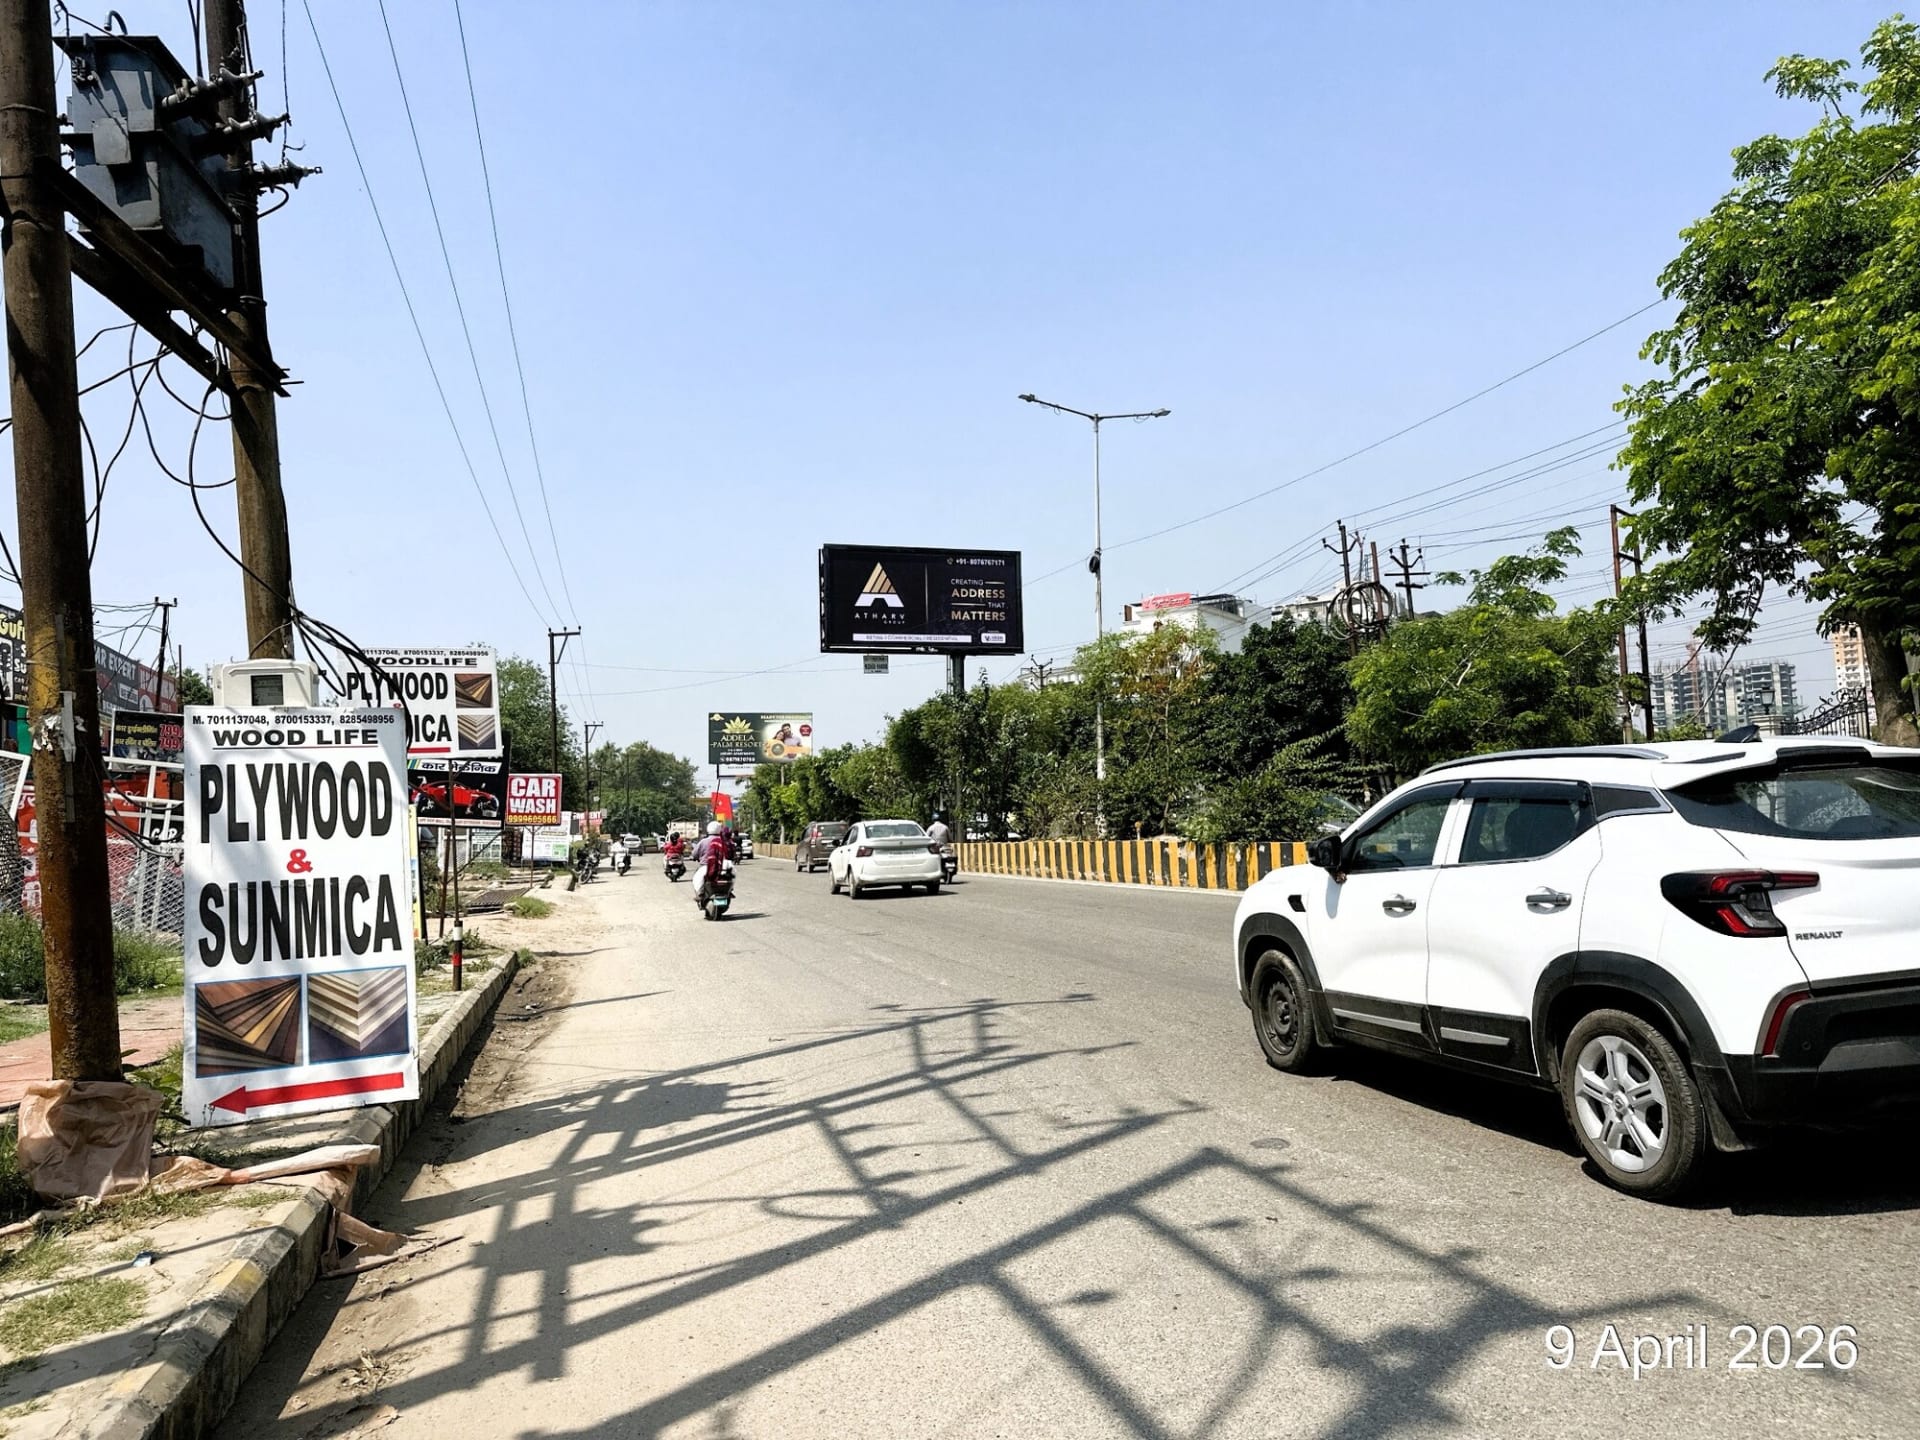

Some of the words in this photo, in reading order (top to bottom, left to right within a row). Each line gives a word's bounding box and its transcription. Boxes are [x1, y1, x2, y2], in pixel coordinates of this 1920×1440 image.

[951, 578, 984, 586] CREATING
[951, 589, 1006, 599] ADDRESS
[988, 601, 1005, 609] THAT
[854, 612, 905, 620] ATHARV
[951, 610, 1006, 621] MATTERS
[95, 645, 107, 669] AR
[108, 652, 136, 681] EXPERT
[347, 672, 448, 700] PLYWOOD
[192, 715, 205, 725] M.
[207, 715, 270, 726] 7011137048,
[274, 715, 335, 726] 8700153337,
[339, 715, 395, 725] 8285498956
[414, 714, 452, 742] ICA
[213, 729, 306, 747] WOOD
[316, 728, 378, 746] LIFE
[422, 761, 447, 771] कार
[510, 777, 556, 798] CAR
[199, 760, 393, 844] PLYWOOD
[509, 798, 557, 814] WASH
[286, 848, 313, 873] &
[198, 874, 402, 968] SUNMICA
[1795, 931, 1843, 941] RENAULT
